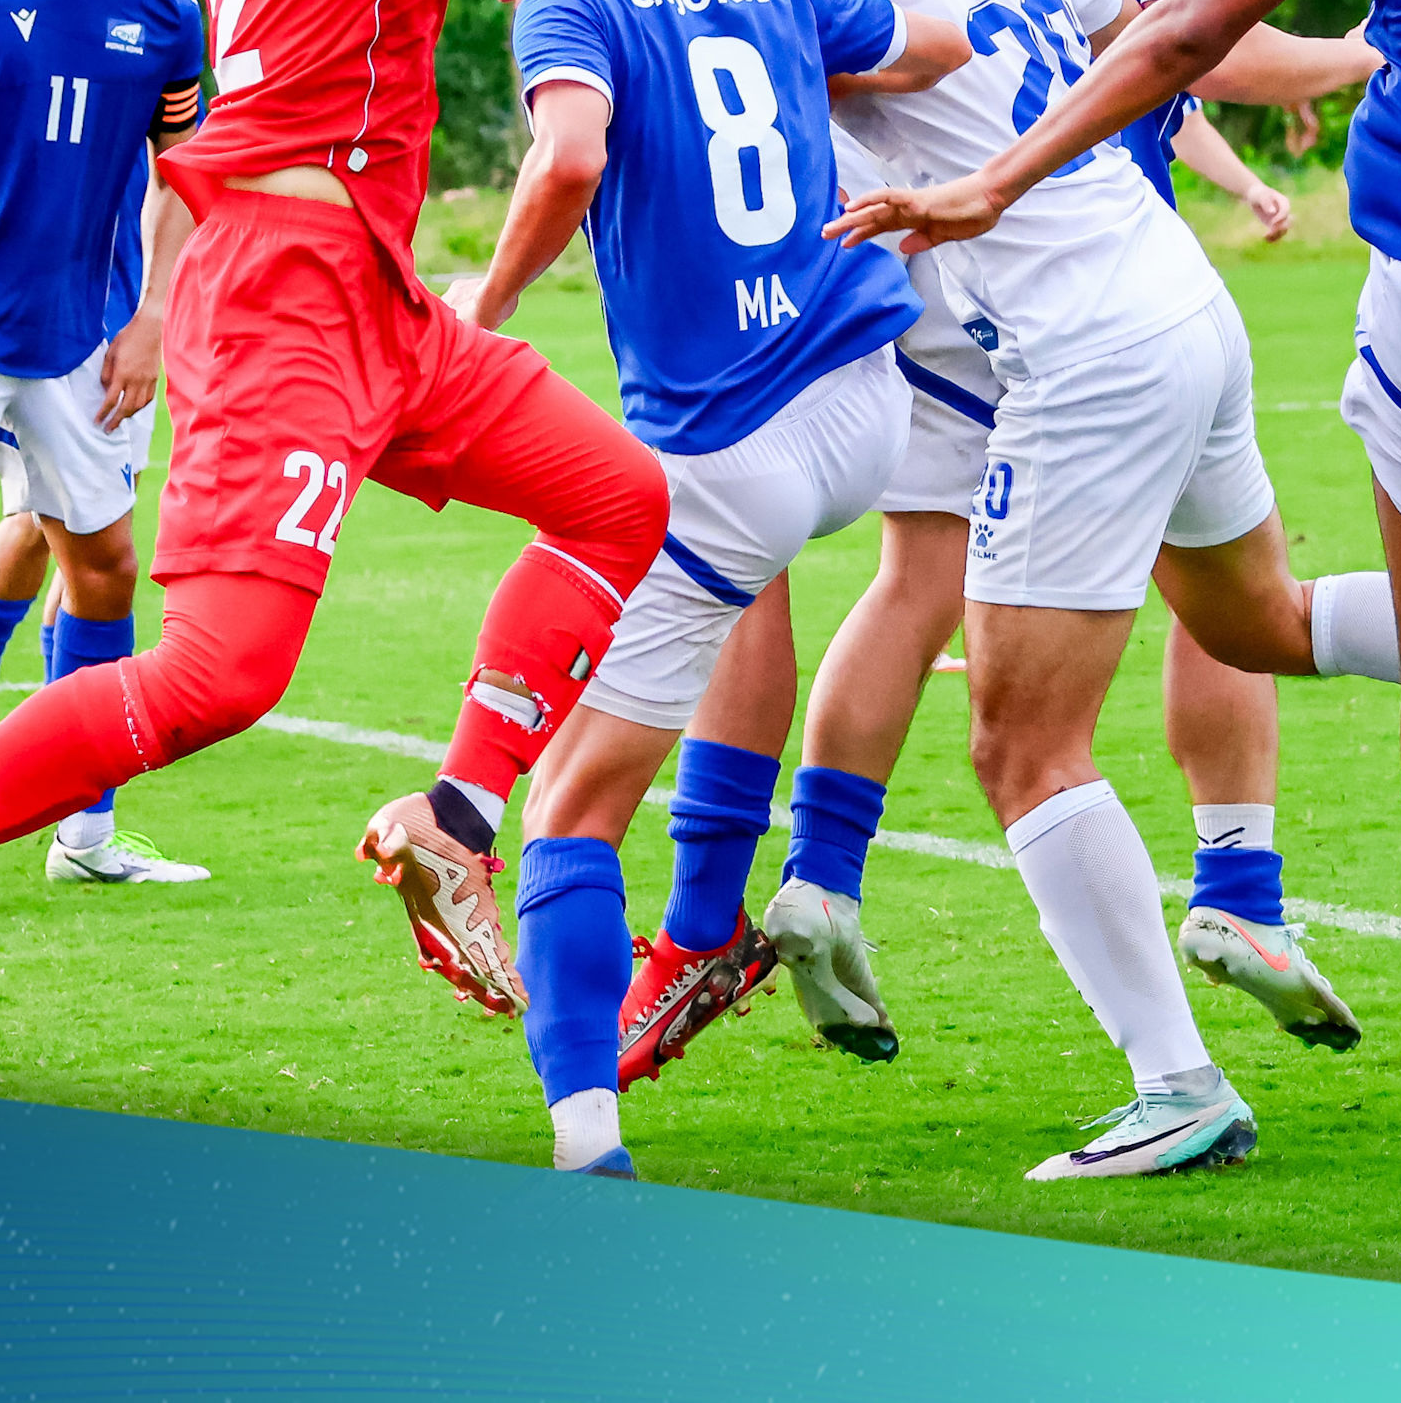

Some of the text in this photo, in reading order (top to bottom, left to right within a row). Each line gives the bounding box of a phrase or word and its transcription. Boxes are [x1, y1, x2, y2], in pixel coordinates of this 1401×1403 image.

[45, 75, 89, 144] 11
[687, 35, 797, 247] 8
[734, 273, 800, 331] MA
[274, 450, 348, 556] 22
